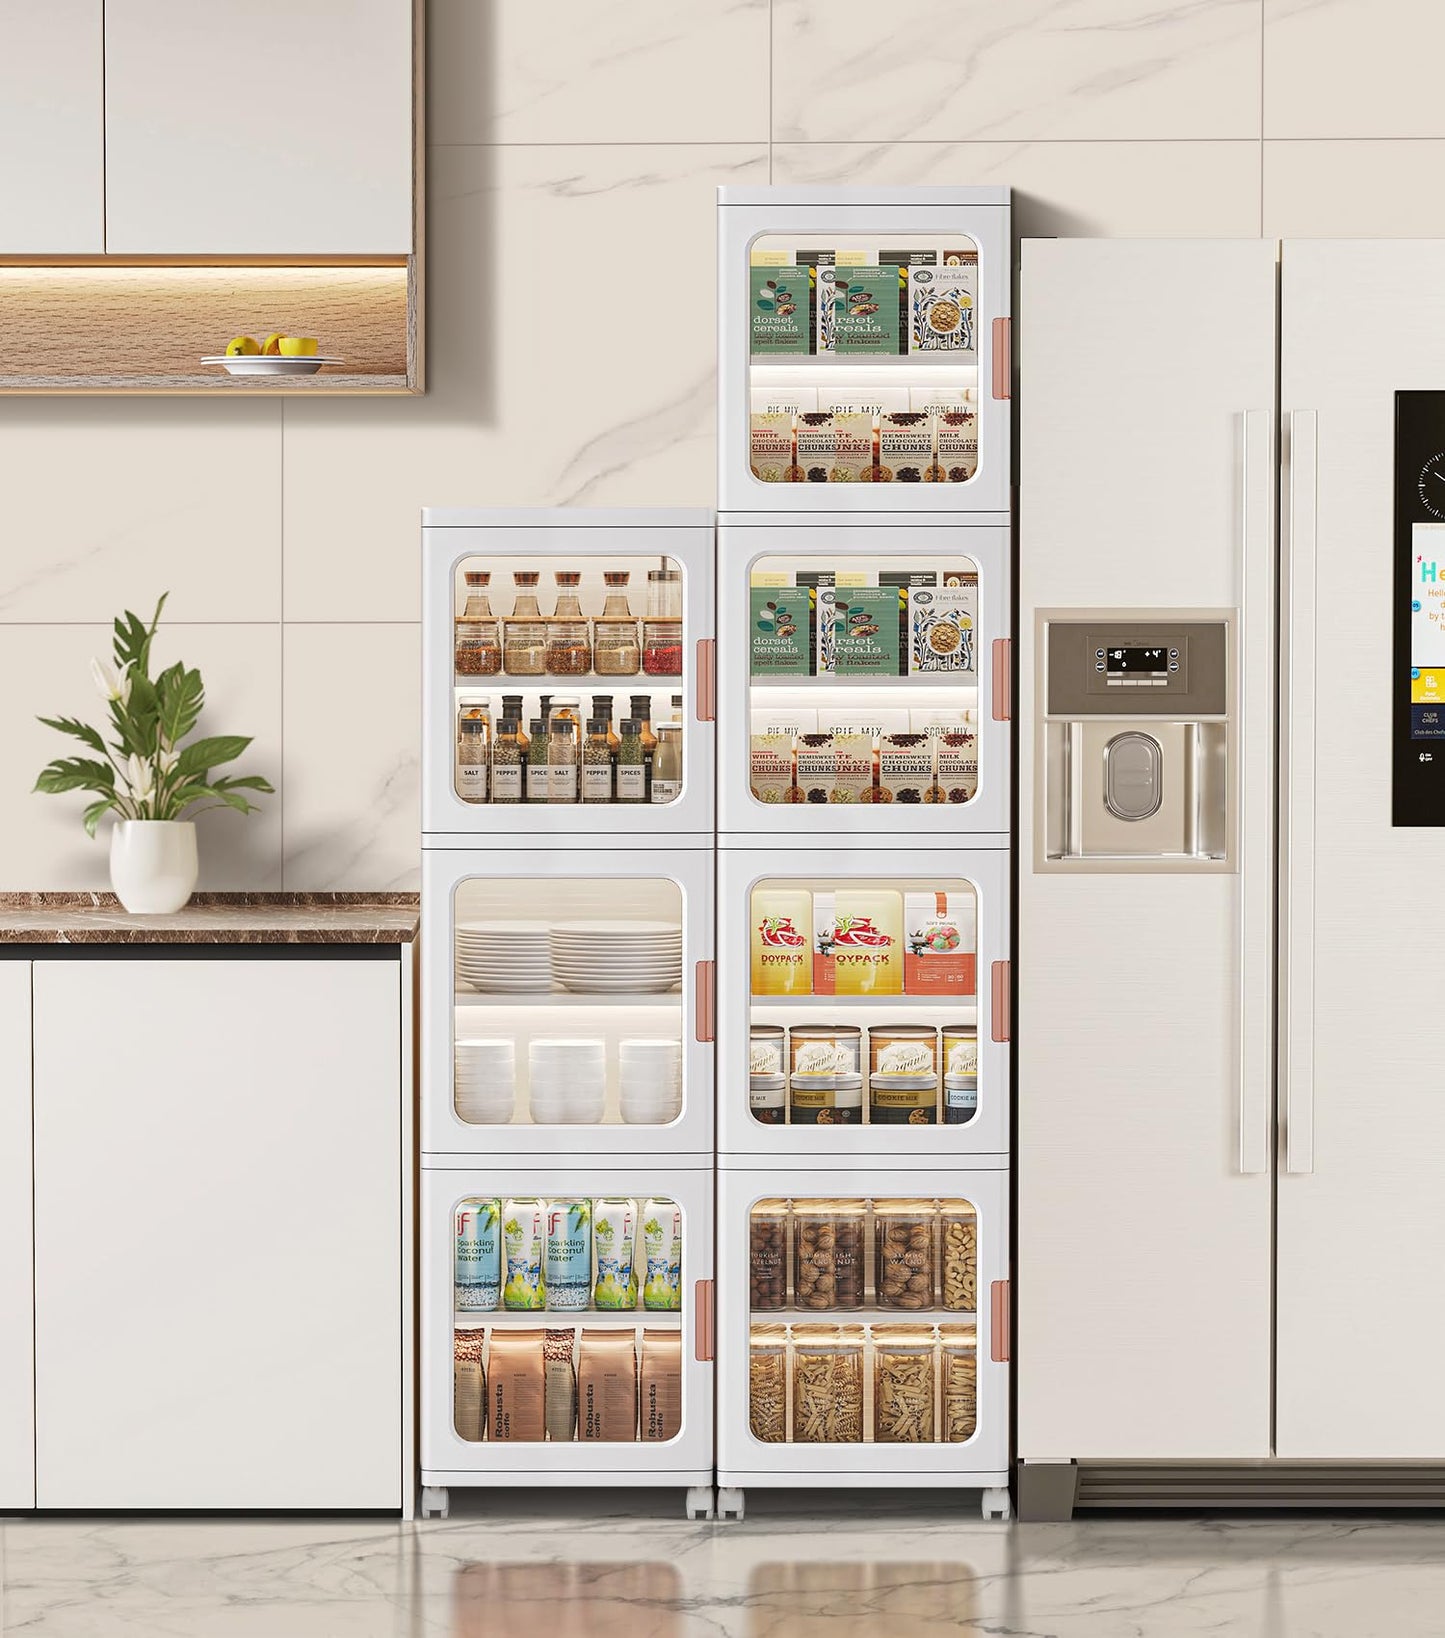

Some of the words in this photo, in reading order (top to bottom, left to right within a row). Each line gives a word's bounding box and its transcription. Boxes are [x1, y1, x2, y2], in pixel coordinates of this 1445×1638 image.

[753, 316, 794, 324] dorset
[753, 636, 794, 645] dorset
[836, 954, 890, 963] OYPACK
